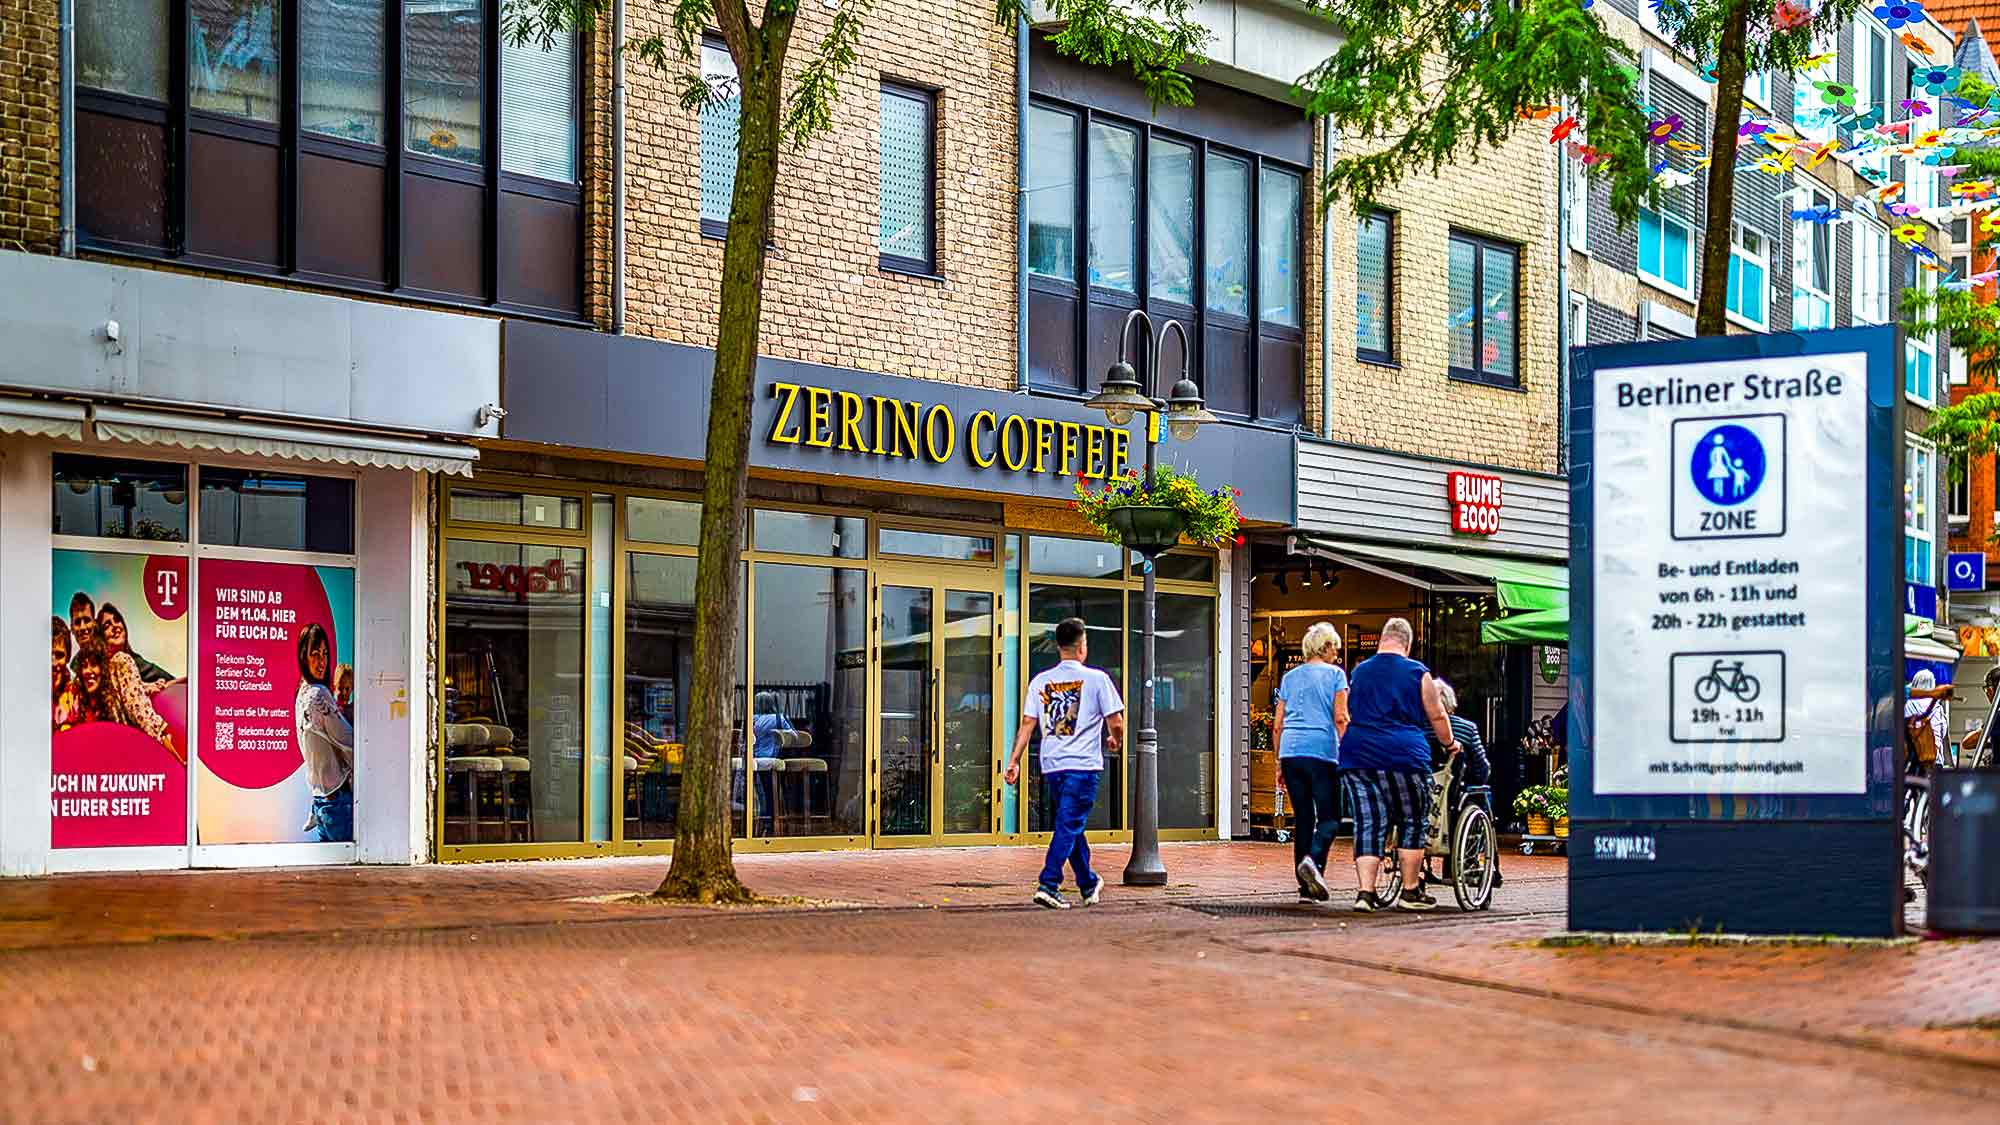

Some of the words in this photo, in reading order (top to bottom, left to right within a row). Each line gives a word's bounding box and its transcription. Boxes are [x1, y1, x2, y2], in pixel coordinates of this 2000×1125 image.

[1618, 378, 1734, 408] Berliner
[1744, 369, 1842, 400] Straße
[770, 383, 956, 464] ZERINO
[970, 410, 1130, 481] COFFEE
[1455, 475, 1501, 506] BLUME
[1460, 504, 1499, 531] 2000
[1700, 510, 1757, 531] ZONE
[1658, 562, 1684, 578] Be-
[1689, 561, 1721, 577] und
[1726, 559, 1799, 576] Entladen
[215, 587, 238, 602] WIR
[240, 589, 266, 604] SIND
[267, 591, 283, 604] AB
[1659, 591, 1690, 604] von
[1694, 587, 1714, 603] 6h
[1731, 585, 1760, 602] 11h
[1765, 584, 1797, 600] und
[216, 607, 239, 620] DEM
[241, 608, 270, 622] 11.04.
[272, 609, 296, 623] HIER
[1652, 613, 1682, 630] 20h
[1697, 612, 1727, 629] 22h
[1732, 611, 1805, 631] gestattet
[215, 621, 237, 638] FÜR
[239, 625, 268, 640] EUCH
[269, 627, 288, 641] DA:
[215, 653, 245, 665] Telekom
[246, 655, 265, 667] Shop
[215, 666, 242, 678] Berliner
[244, 667, 256, 678] Str.
[257, 668, 266, 678] 47
[239, 680, 272, 691] Gütersloh
[215, 706, 233, 717] Rund
[234, 708, 244, 717] um
[246, 707, 256, 717] die
[257, 707, 269, 717] Uhr
[1692, 708, 1720, 723] 19h
[1735, 708, 1764, 723] 11h
[237, 727, 274, 737] telekom.de
[275, 728, 290, 737] oder
[1649, 761, 1669, 774] mit
[1672, 761, 1804, 776] Schrittgeschwindigkeit
[82, 774, 97, 792] IN
[100, 773, 165, 792] ZUKUNFT
[61, 798, 109, 816] EURER
[111, 798, 150, 816] SEITE
